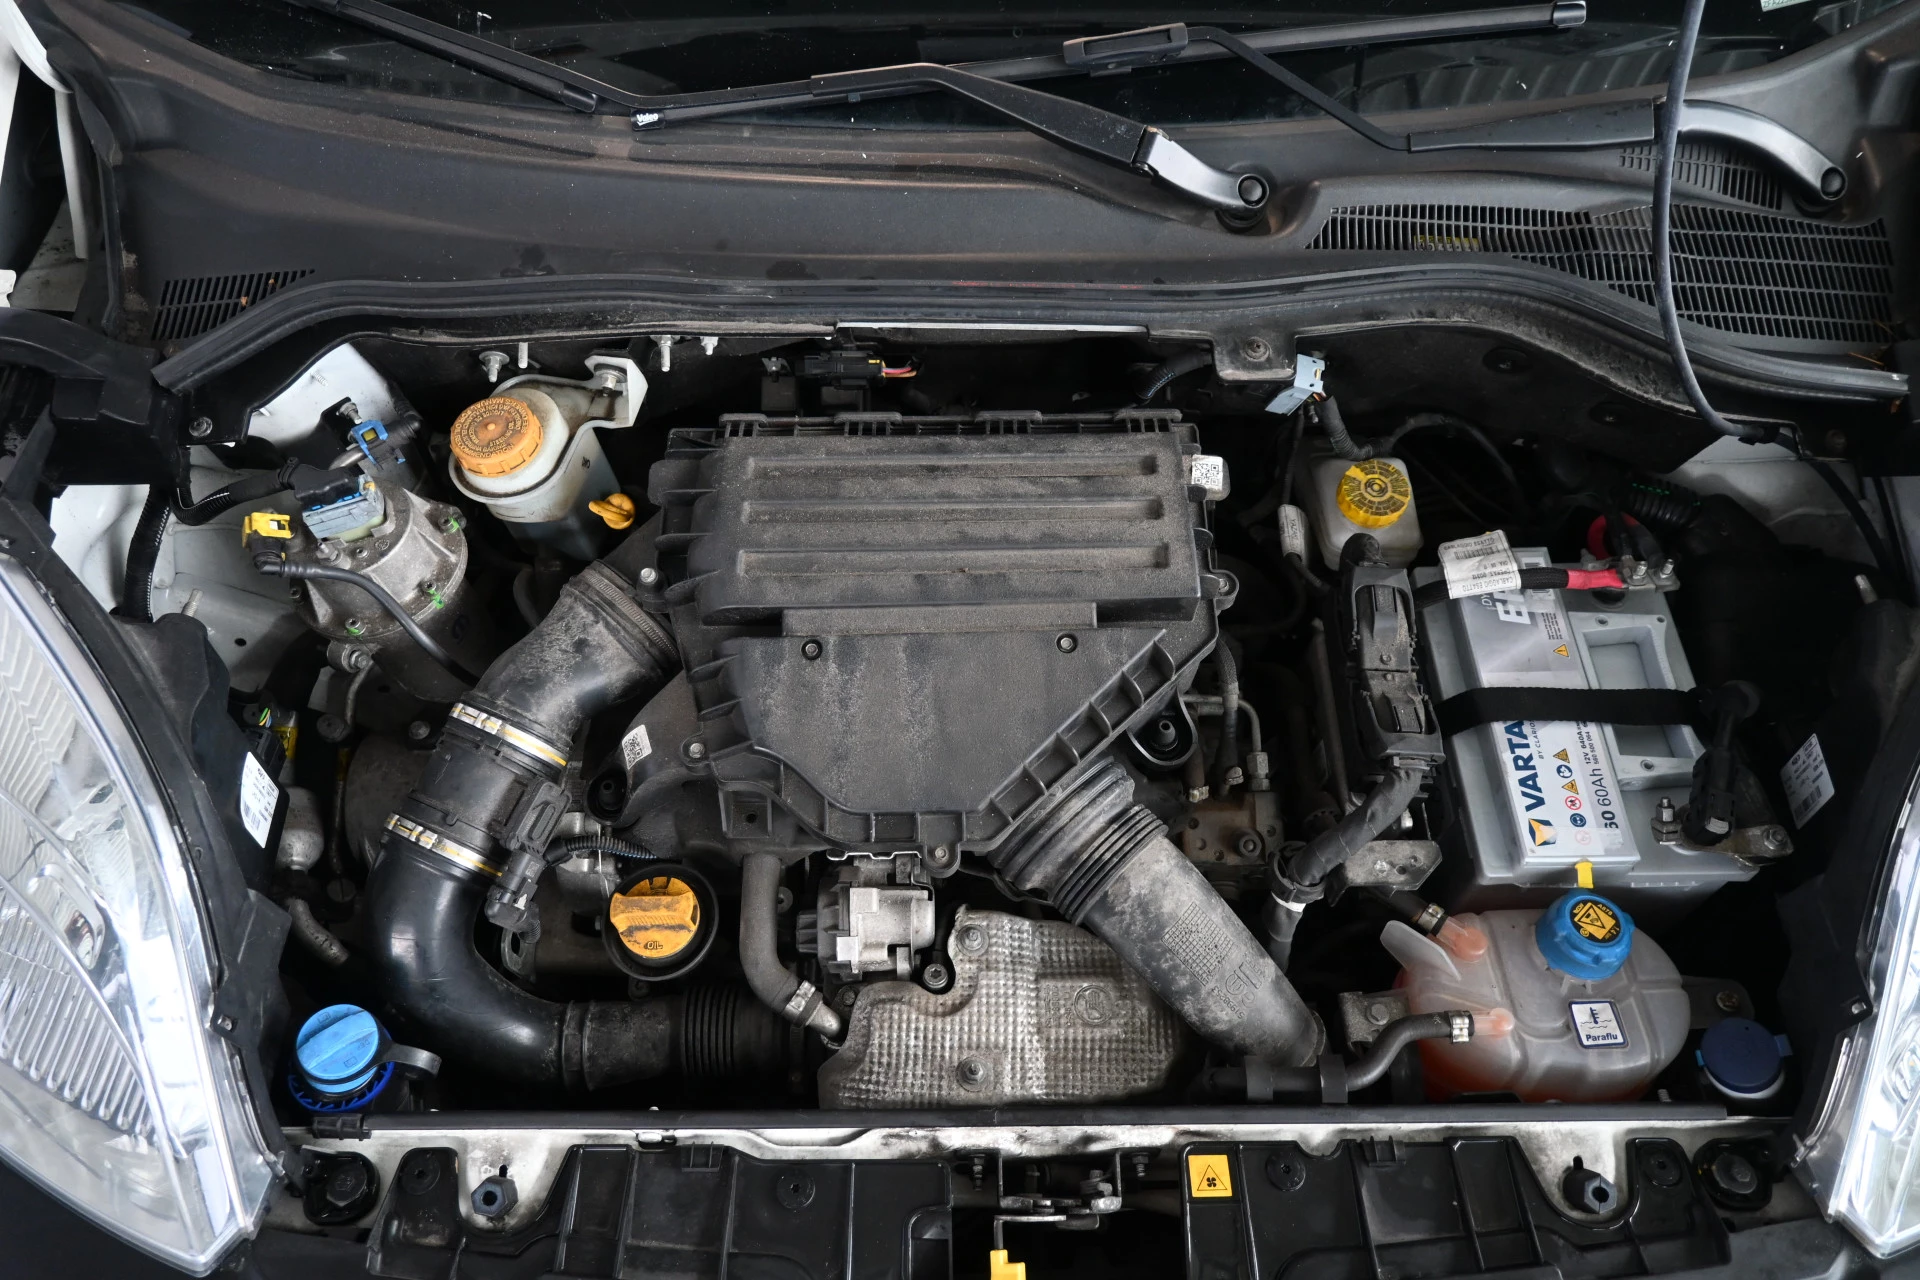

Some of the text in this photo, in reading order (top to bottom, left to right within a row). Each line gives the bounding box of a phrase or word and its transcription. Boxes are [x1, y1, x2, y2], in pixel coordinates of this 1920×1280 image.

[636, 113, 658, 122] Valeo
[1529, 720, 1544, 759] BY CLARIO
[1583, 752, 1591, 765] 12V
[1504, 720, 1546, 812] VARTA
[1590, 768, 1612, 807] 60Ah
[647, 941, 663, 950] OIL
[1585, 1033, 1618, 1042] Paraflu
